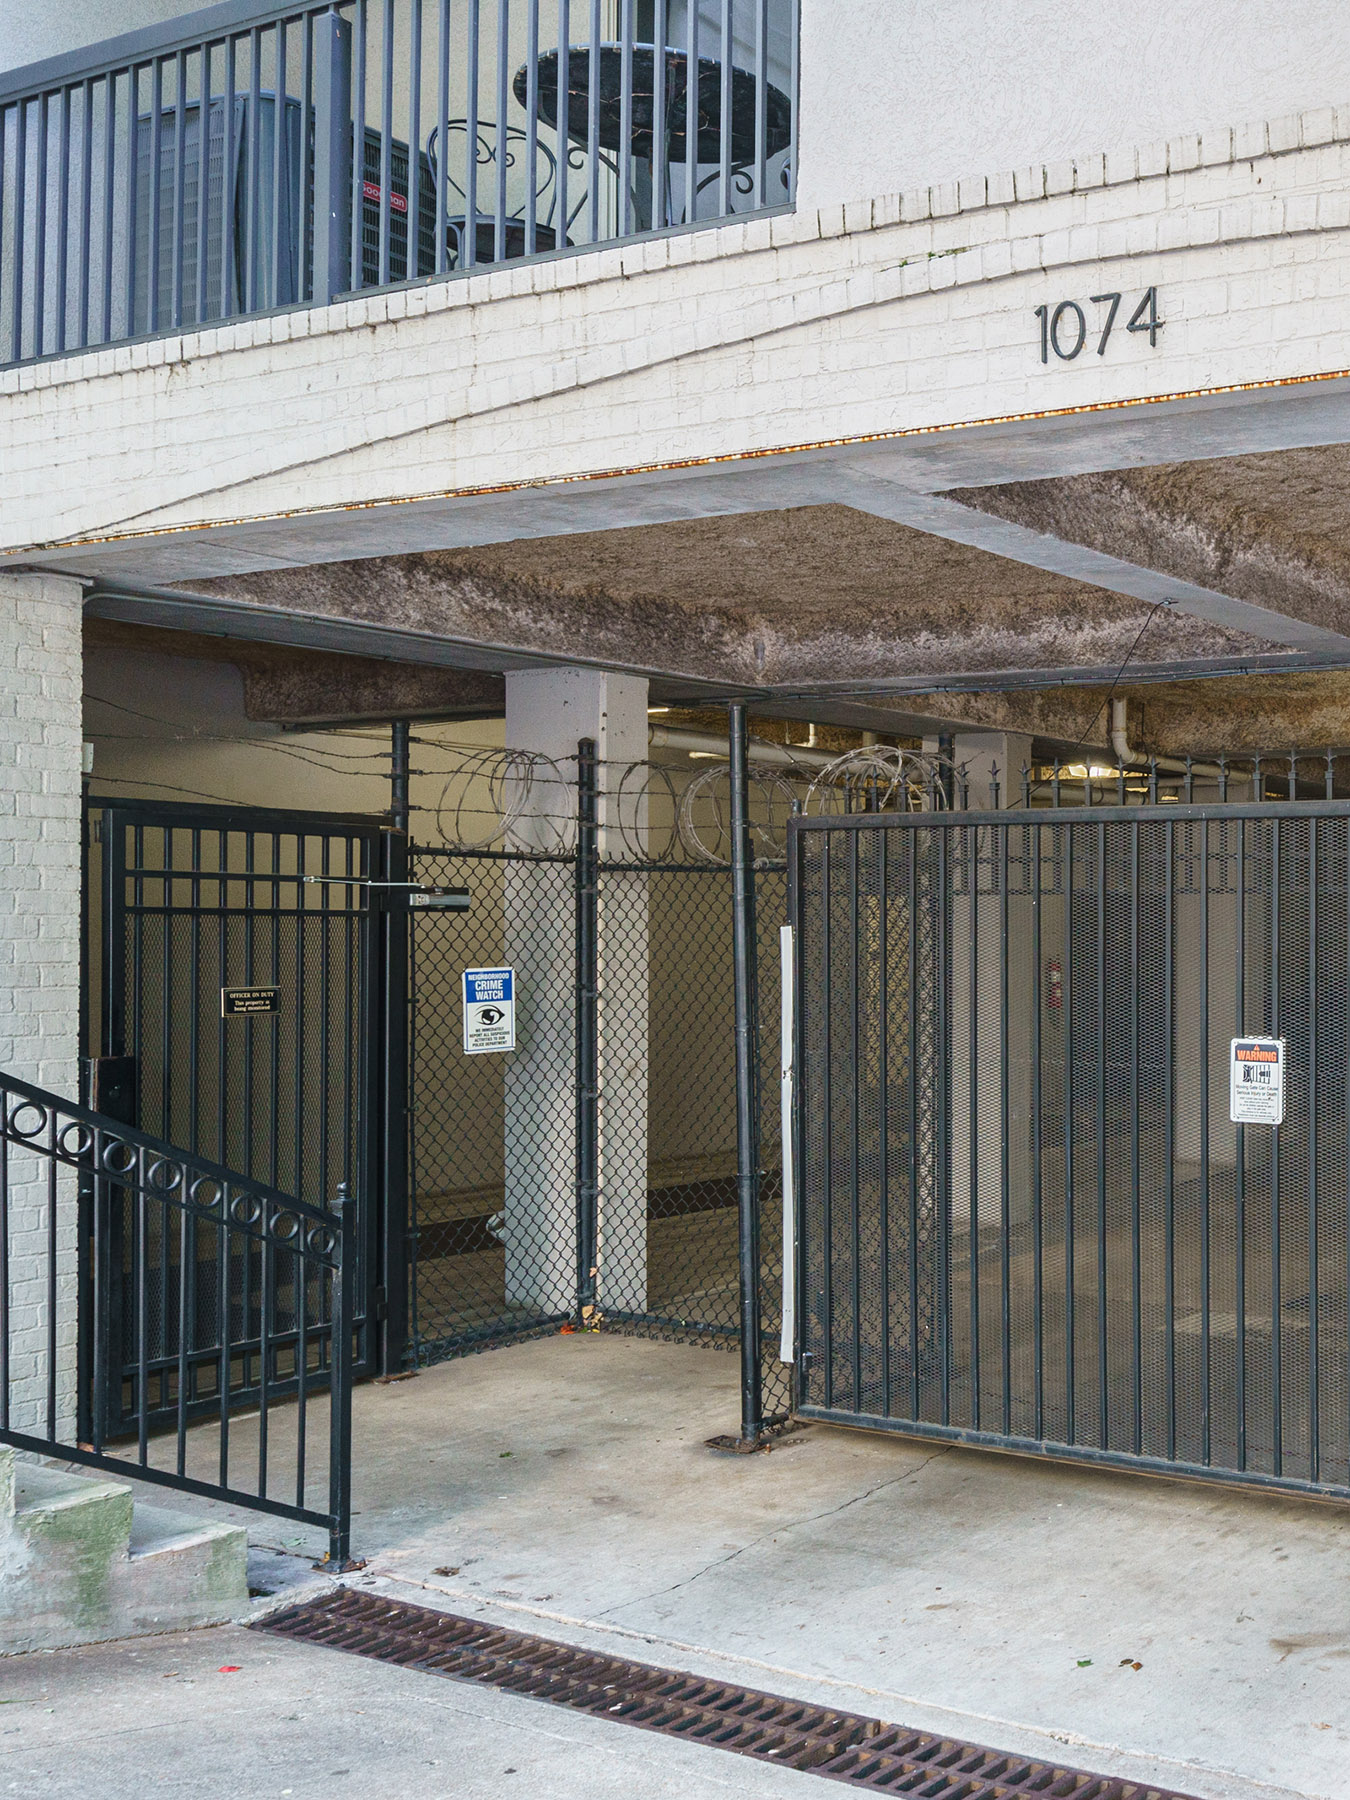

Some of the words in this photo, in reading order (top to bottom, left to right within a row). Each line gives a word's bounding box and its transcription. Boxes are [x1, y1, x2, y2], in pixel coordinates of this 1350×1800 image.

[1034, 286, 1165, 364] 1074
[468, 973, 509, 981] NEIGHBORHOOD
[475, 980, 504, 991] CRIME
[475, 990, 504, 1001] WATCH
[1236, 1050, 1277, 1062] WARNING
